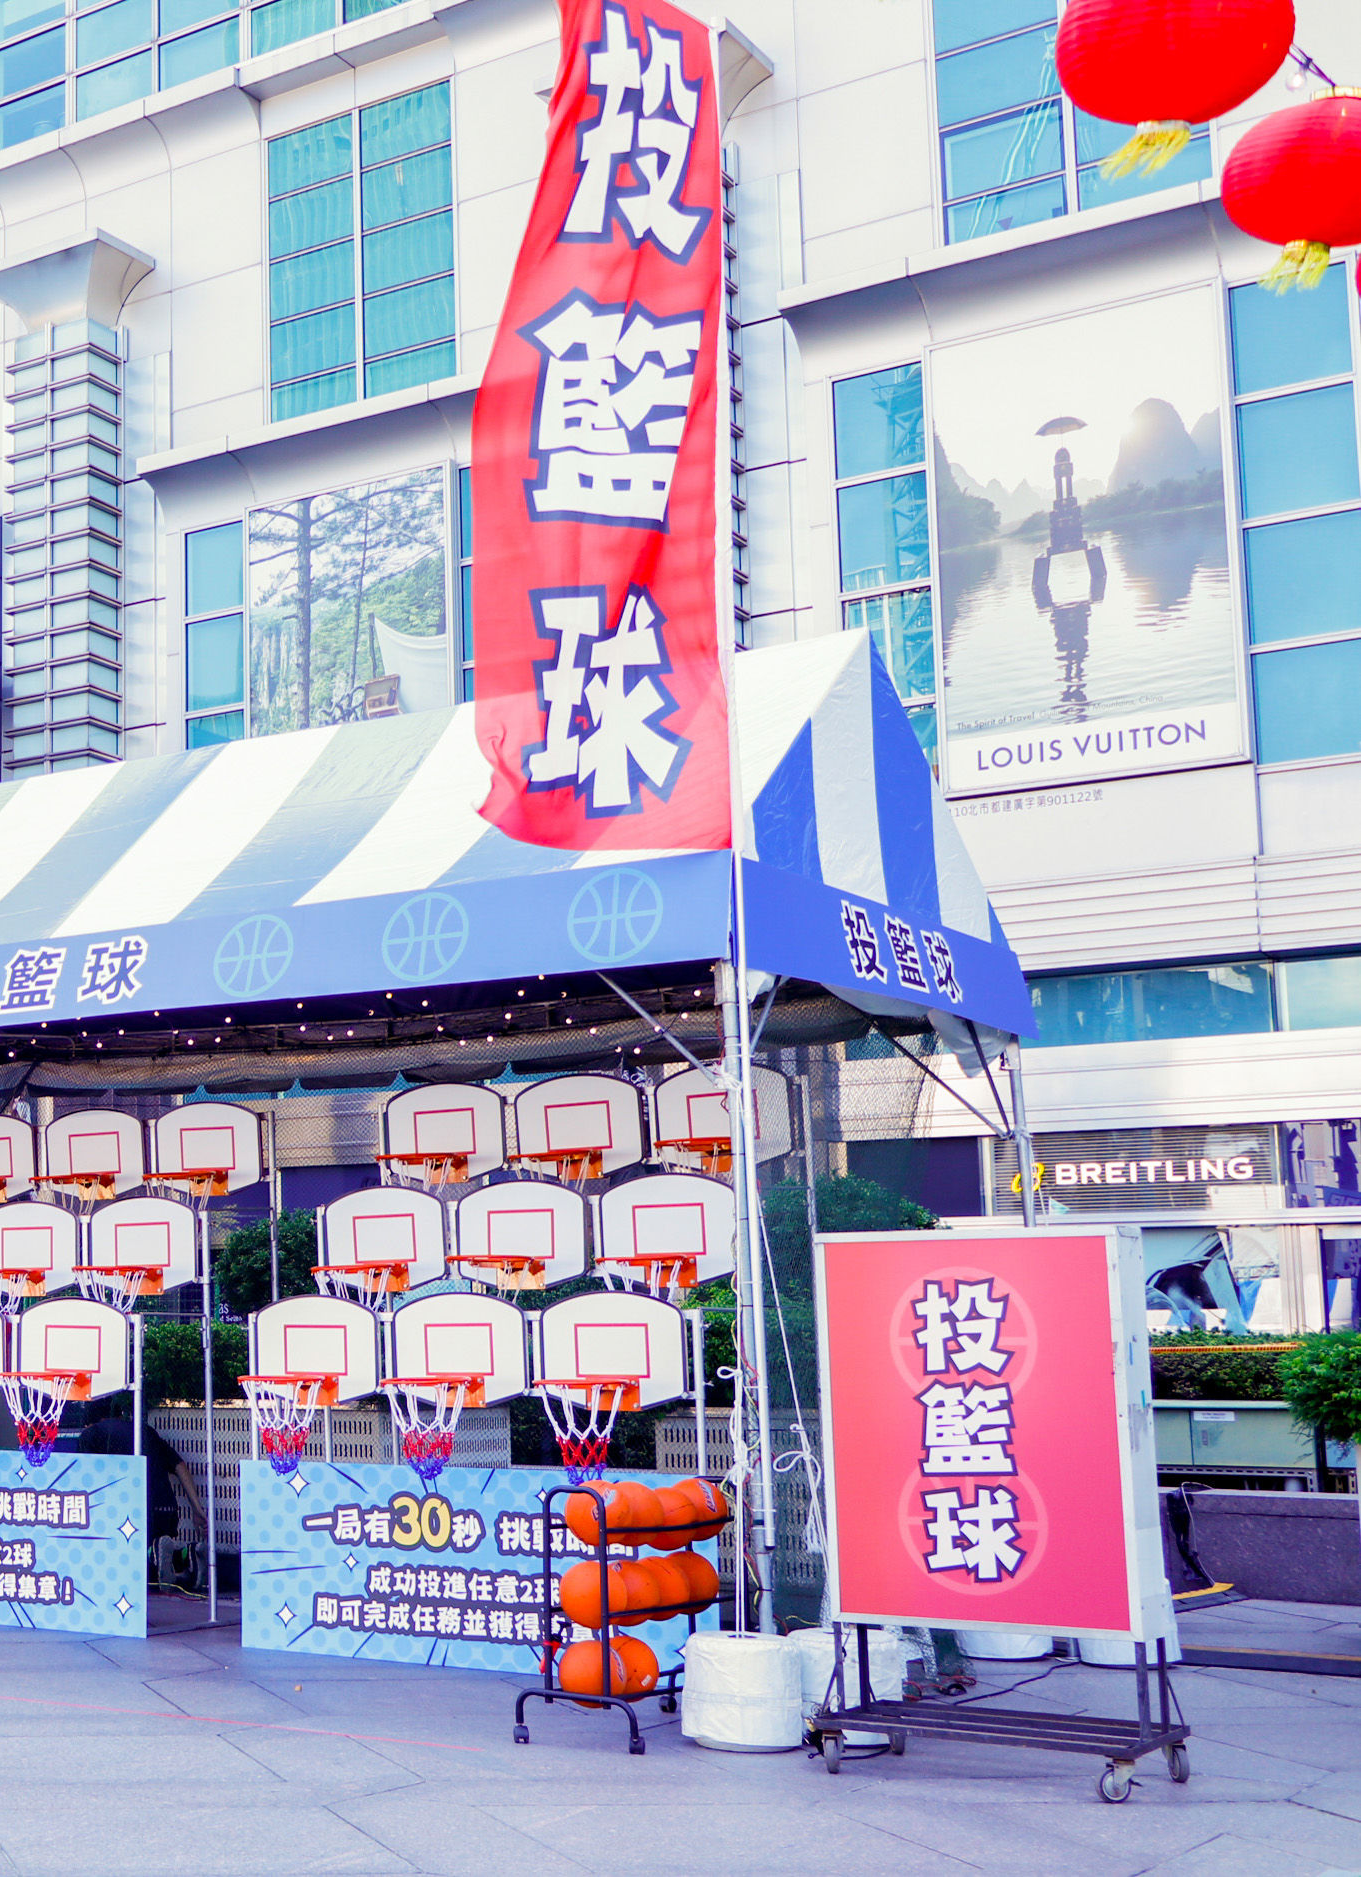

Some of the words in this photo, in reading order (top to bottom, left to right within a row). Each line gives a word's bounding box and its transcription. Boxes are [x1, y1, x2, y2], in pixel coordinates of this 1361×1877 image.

[519, 8, 713, 816] 投籃球
[977, 739, 1063, 771] LOUIS
[1072, 719, 1207, 757] VUITTON
[840, 899, 963, 1004] 投籃球
[1054, 1156, 1254, 1186] BREITLING
[912, 1277, 1026, 1583] 投籃球
[305, 1495, 482, 1550] 一局有30秒
[368, 1566, 560, 1606] 成功投進任意2球
